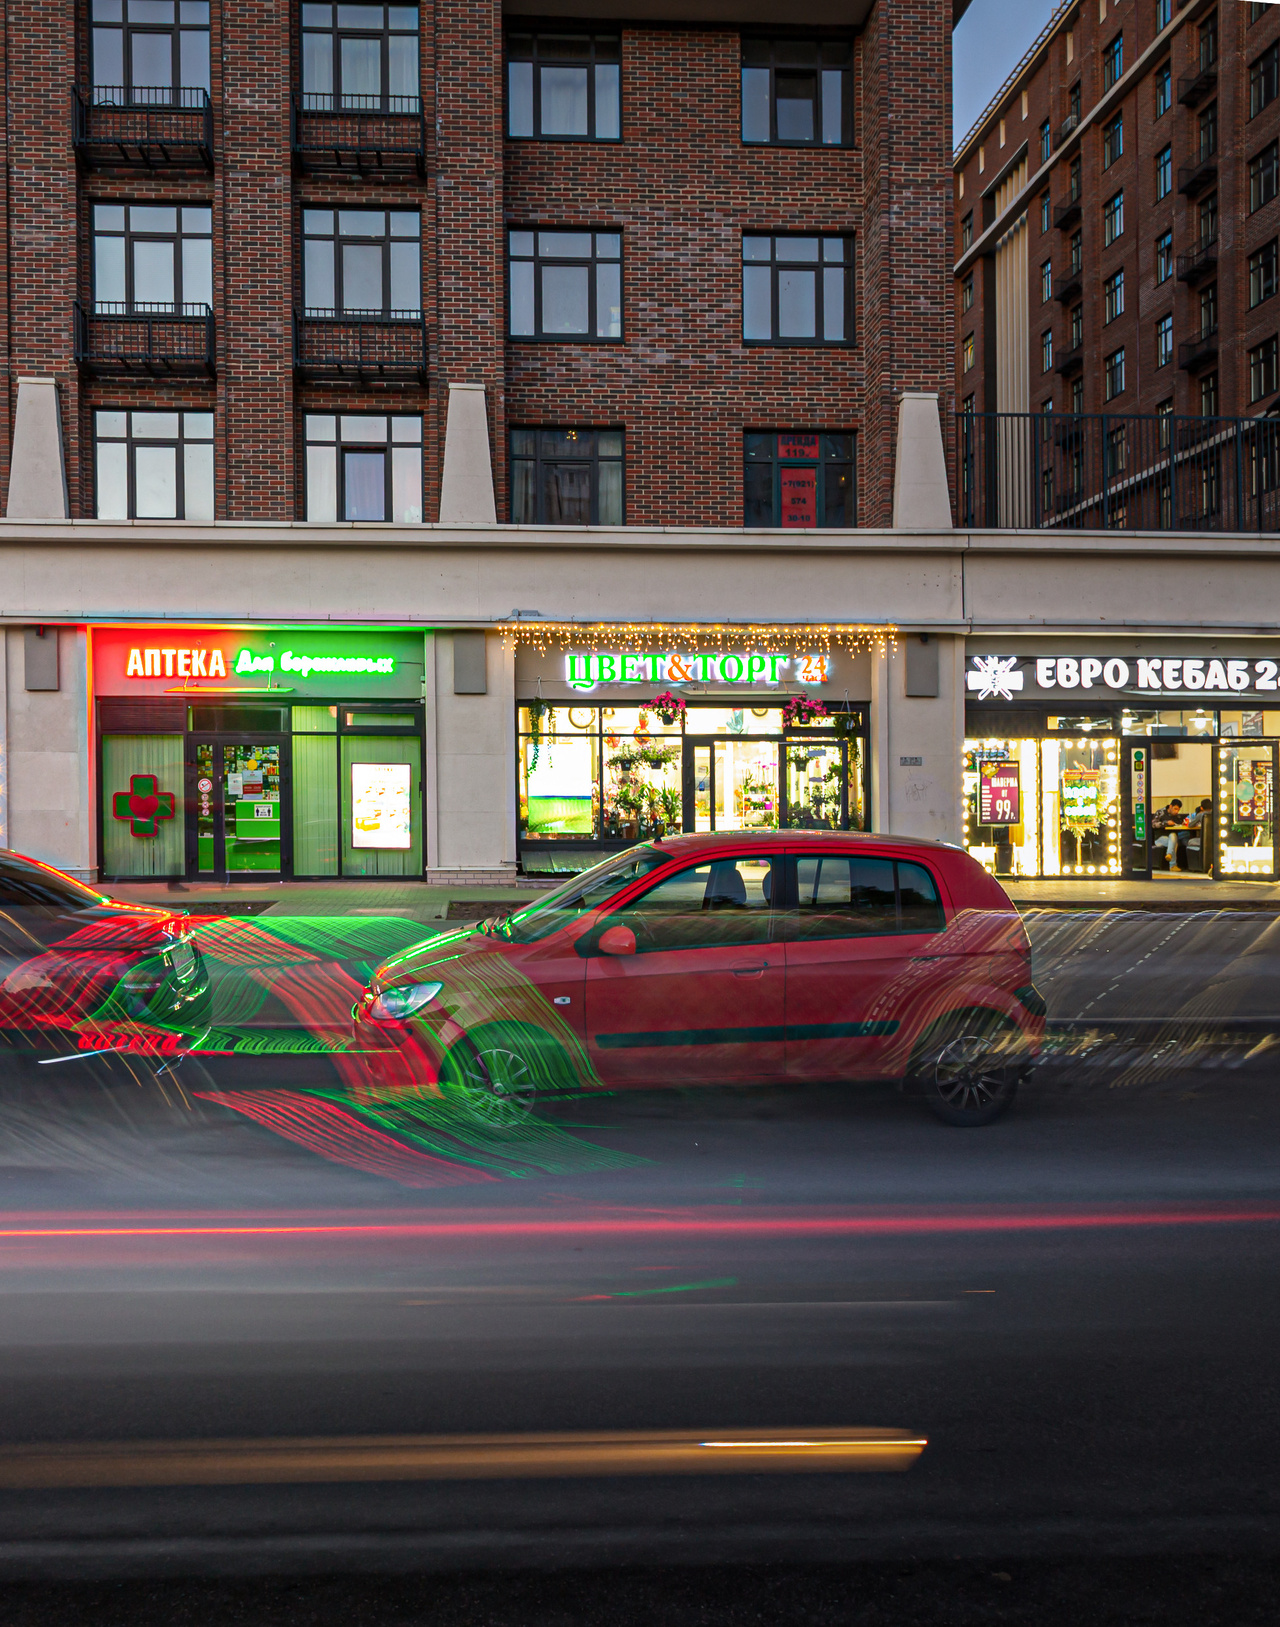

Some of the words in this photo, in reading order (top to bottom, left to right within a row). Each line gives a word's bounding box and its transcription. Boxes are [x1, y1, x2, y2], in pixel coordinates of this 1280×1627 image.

[126, 649, 227, 677] АПТЕКА
[567, 653, 789, 689] ЦВЕТ&ТОРГ
[801, 654, 827, 675] 24
[1035, 657, 1130, 689] ЕВРО
[1136, 658, 1251, 690] КЕБАБ
[1254, 660, 1280, 690] 2
